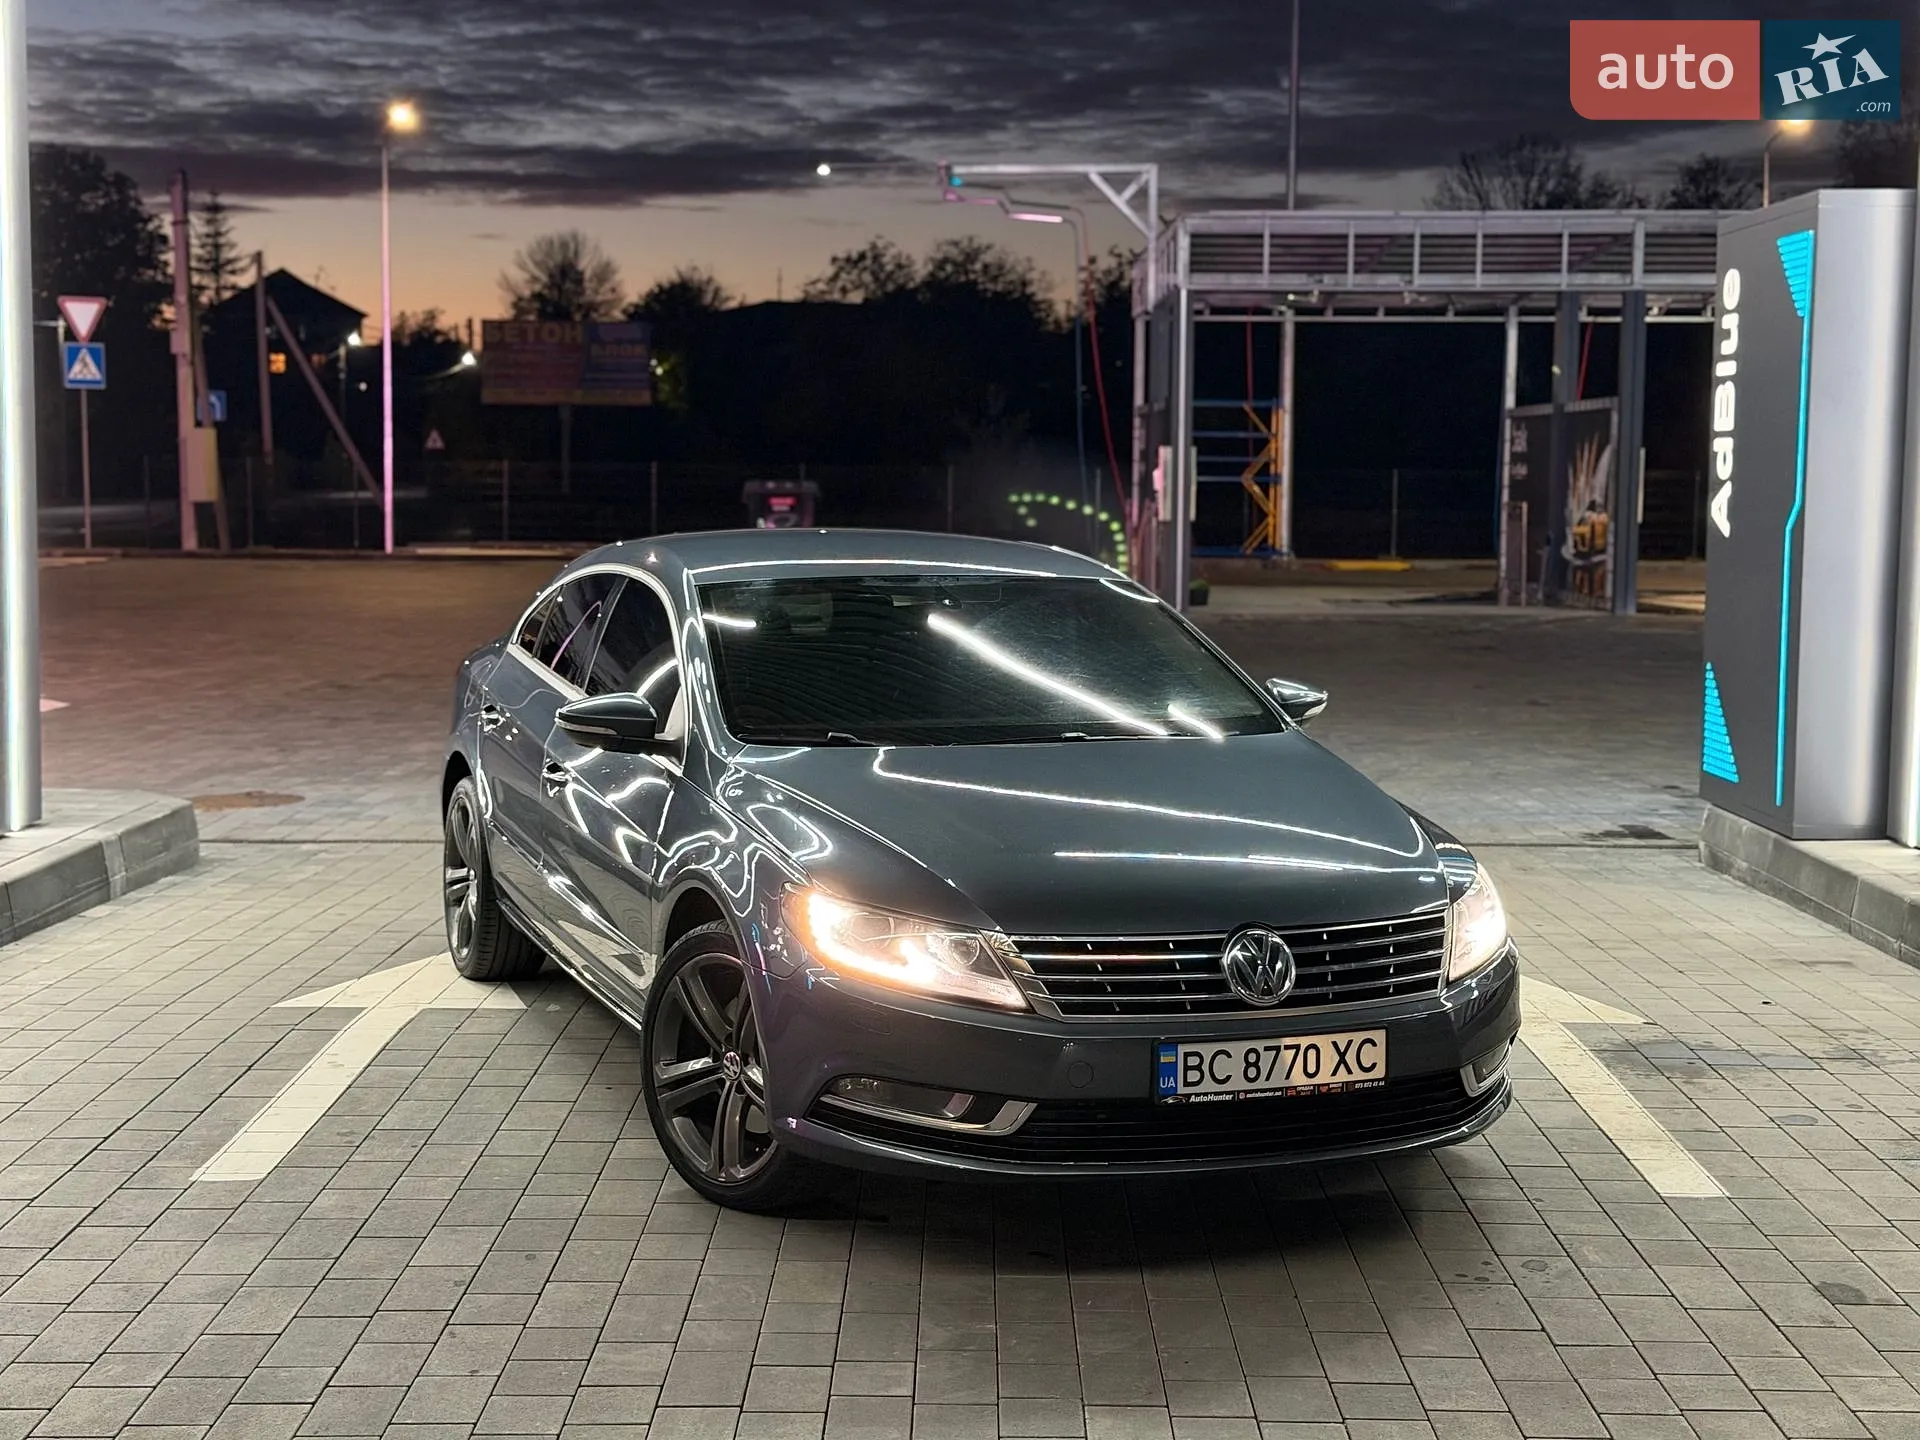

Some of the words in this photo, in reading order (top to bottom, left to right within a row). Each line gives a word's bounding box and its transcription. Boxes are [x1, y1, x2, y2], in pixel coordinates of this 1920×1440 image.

[484, 322, 583, 344] БЕТОН
[1711, 268, 1741, 538] AdBlue
[1183, 1048, 1233, 1088] BC
[1243, 1043, 1321, 1084] 8770
[1330, 1037, 1378, 1077] XC
[1160, 1076, 1176, 1088] UA
[1189, 1093, 1234, 1102] AutoHunter
